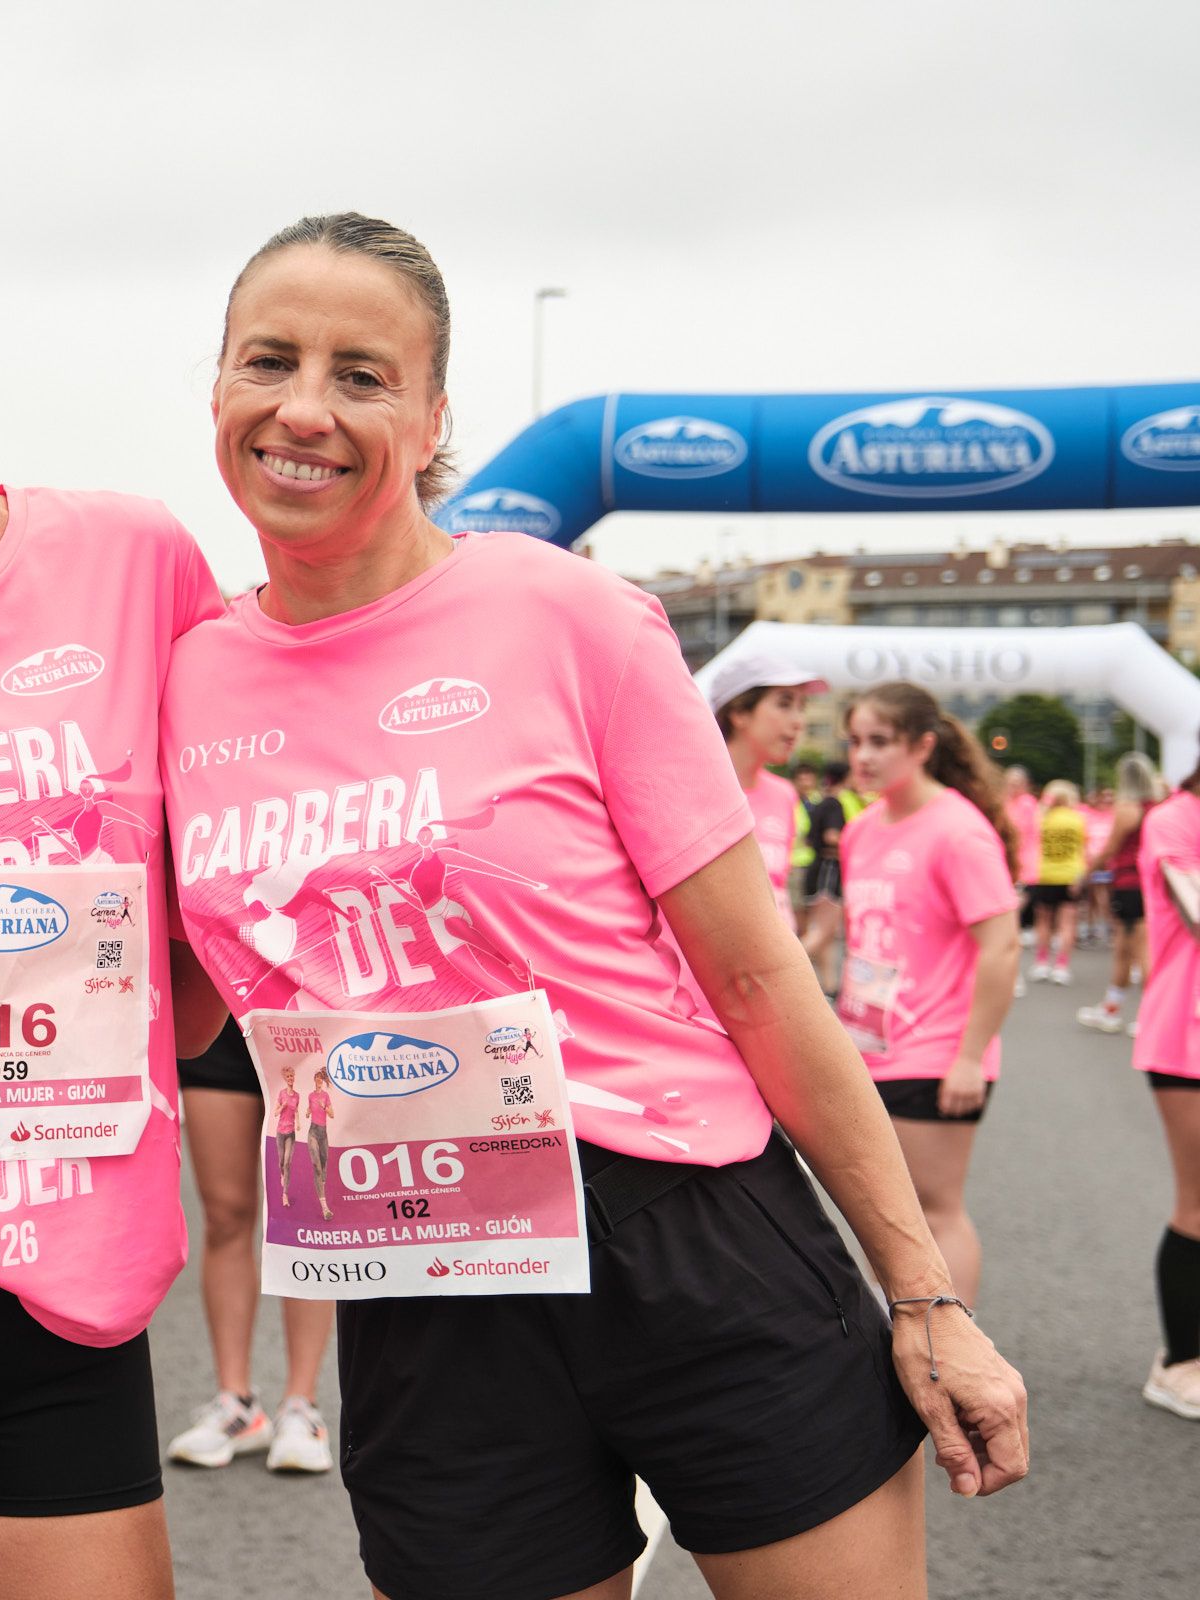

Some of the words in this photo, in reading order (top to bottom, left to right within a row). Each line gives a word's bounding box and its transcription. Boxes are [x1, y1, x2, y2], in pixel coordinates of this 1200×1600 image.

[826, 430, 1034, 474] ASTURIANA
[11, 661, 99, 691] ASTURIANA
[846, 646, 1031, 683] OYSHO
[386, 697, 481, 726] ASTURIANA
[179, 729, 285, 773] OYSHO
[181, 767, 448, 887] CARRERA
[14, 907, 56, 915] LECHERA
[322, 878, 437, 998] DE
[85, 976, 114, 994] gijón
[267, 1026, 280, 1036] TU
[283, 1027, 320, 1038] DORSAL
[273, 1037, 324, 1054] SUMA
[348, 1053, 389, 1063] CENTRAL
[393, 1051, 441, 1061] LECHERA
[334, 1054, 449, 1082] ASTURIANA
[6, 1086, 54, 1103] MUJER
[67, 1080, 106, 1100] GIJÓN
[34, 1121, 119, 1141] Santander
[491, 1113, 530, 1131] gijón
[469, 1136, 561, 1153] CORREDORA
[338, 1142, 464, 1193] 016
[342, 1194, 380, 1202] TELÉFONO
[380, 1190, 418, 1199] VIOLENCIA
[430, 1186, 460, 1194] GÉNERO
[387, 1198, 431, 1220] 162
[297, 1228, 362, 1245] CARRERA
[367, 1226, 387, 1242] DE
[392, 1226, 412, 1241] LA
[416, 1223, 471, 1240] MUJER
[485, 1215, 532, 1235] GIJÓN
[292, 1260, 387, 1283] OYSHO
[453, 1257, 550, 1276] Santander
